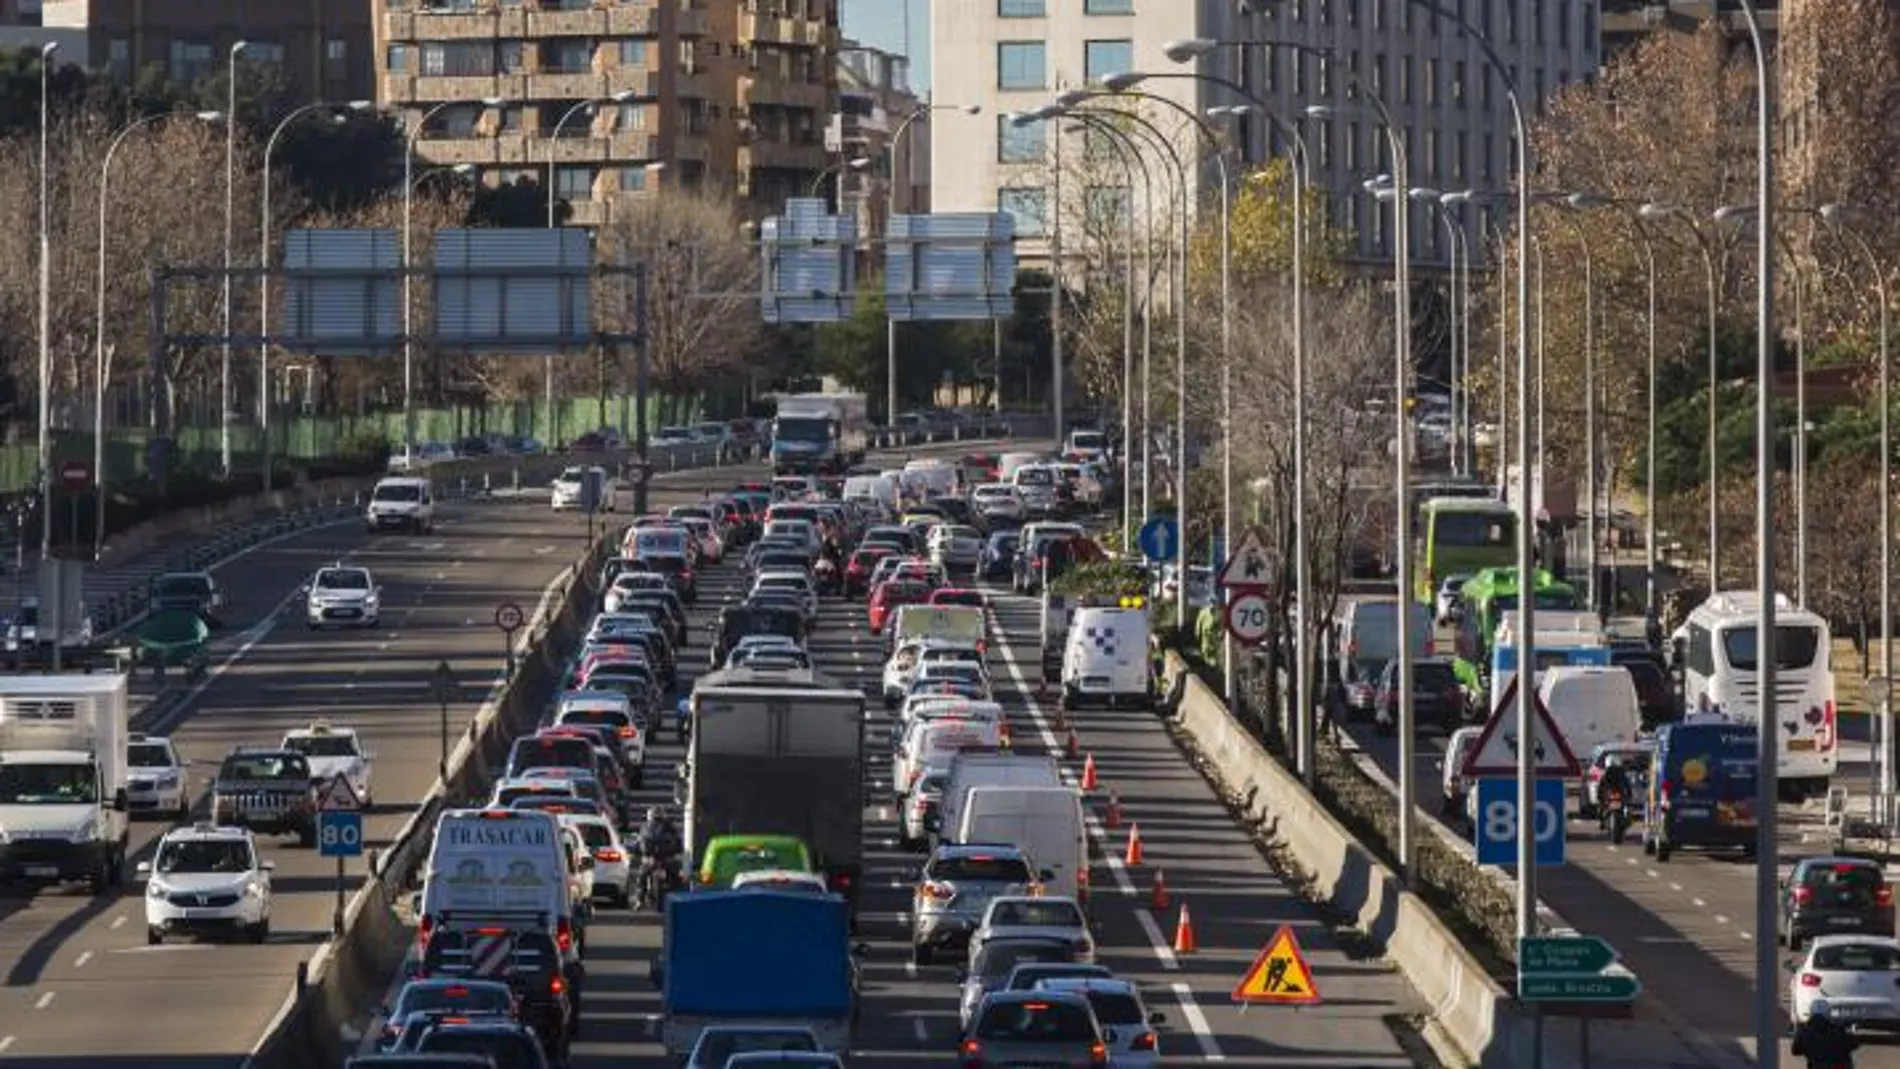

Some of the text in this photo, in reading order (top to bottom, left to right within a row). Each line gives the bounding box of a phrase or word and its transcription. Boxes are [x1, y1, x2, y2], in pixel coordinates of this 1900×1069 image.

[1237, 608, 1265, 628] 70
[1485, 800, 1557, 842] 80
[323, 824, 359, 845] 80
